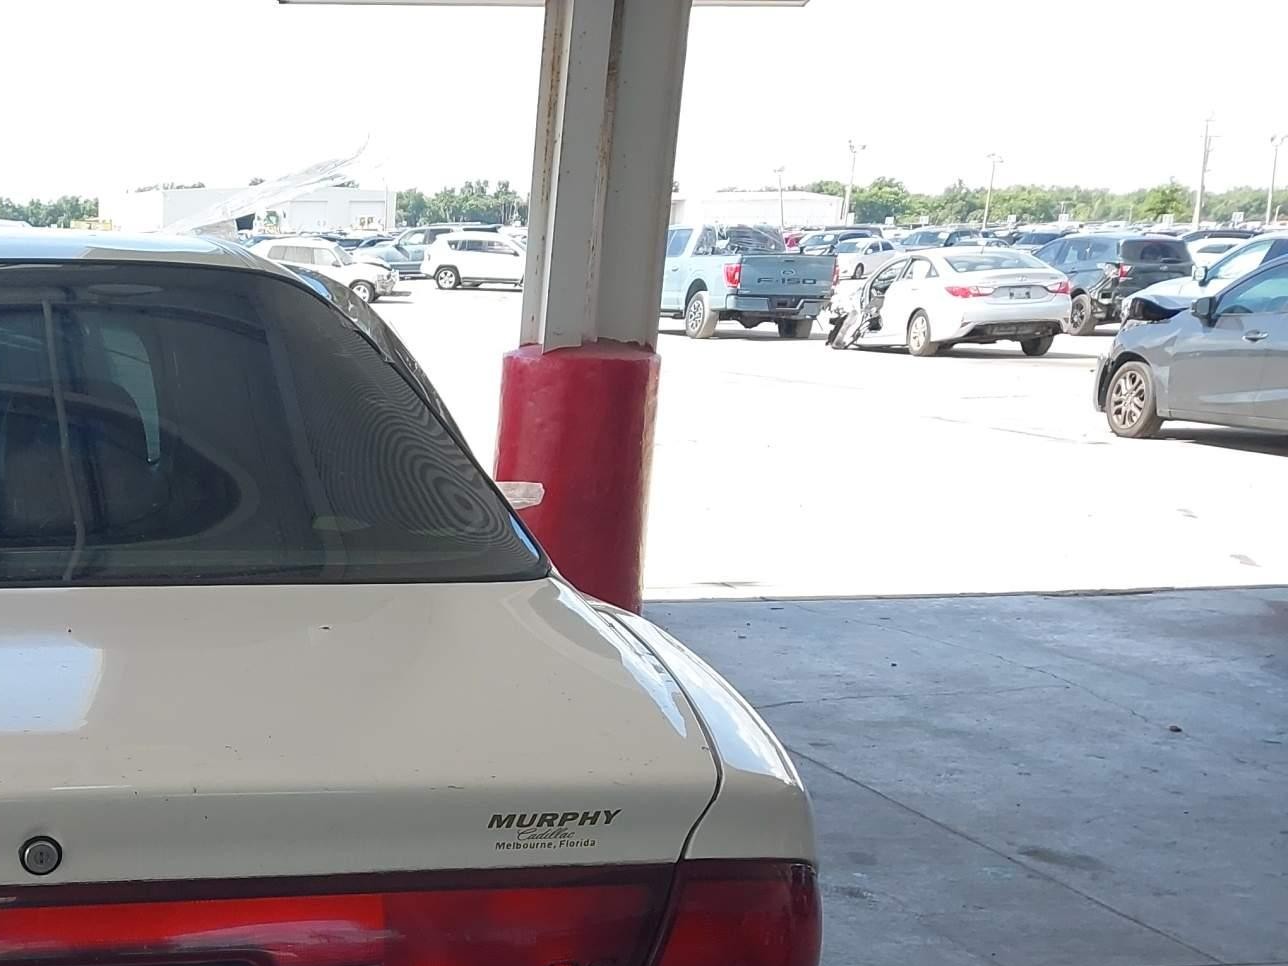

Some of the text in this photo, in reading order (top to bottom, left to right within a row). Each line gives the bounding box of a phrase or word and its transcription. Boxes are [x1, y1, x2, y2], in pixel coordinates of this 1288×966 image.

[757, 277, 817, 285] F-150
[487, 808, 622, 829] MURPHY
[517, 827, 575, 841] Cadillac
[495, 839, 596, 850] Melbourne, Florida
